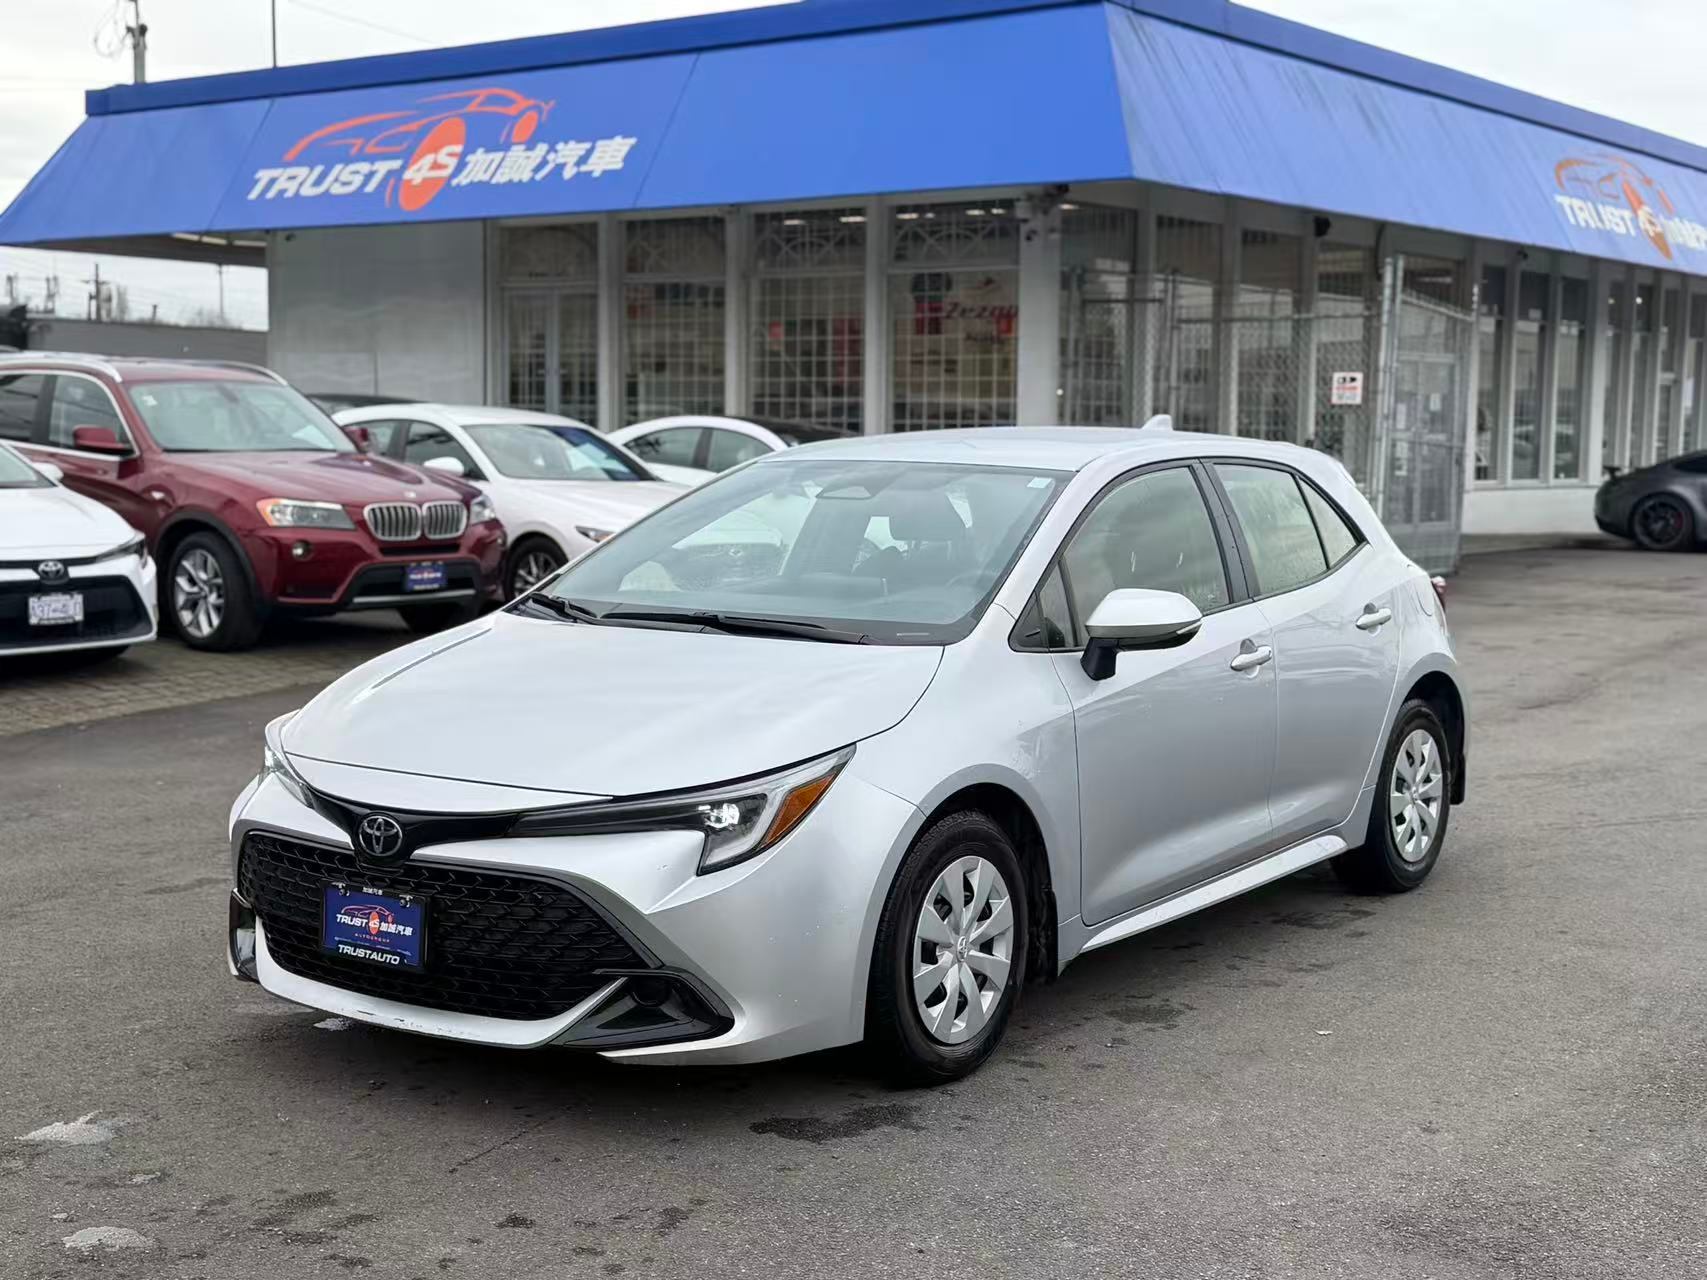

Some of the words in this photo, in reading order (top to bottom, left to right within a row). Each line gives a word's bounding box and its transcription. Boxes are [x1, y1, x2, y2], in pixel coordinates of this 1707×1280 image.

[247, 158, 403, 200] TRUST
[405, 143, 464, 184] 4S
[452, 135, 637, 187] 加誠汽車
[1554, 194, 1636, 237] TRUST
[336, 914, 368, 927] TRUST
[338, 944, 400, 965] TRUSTAUTO
